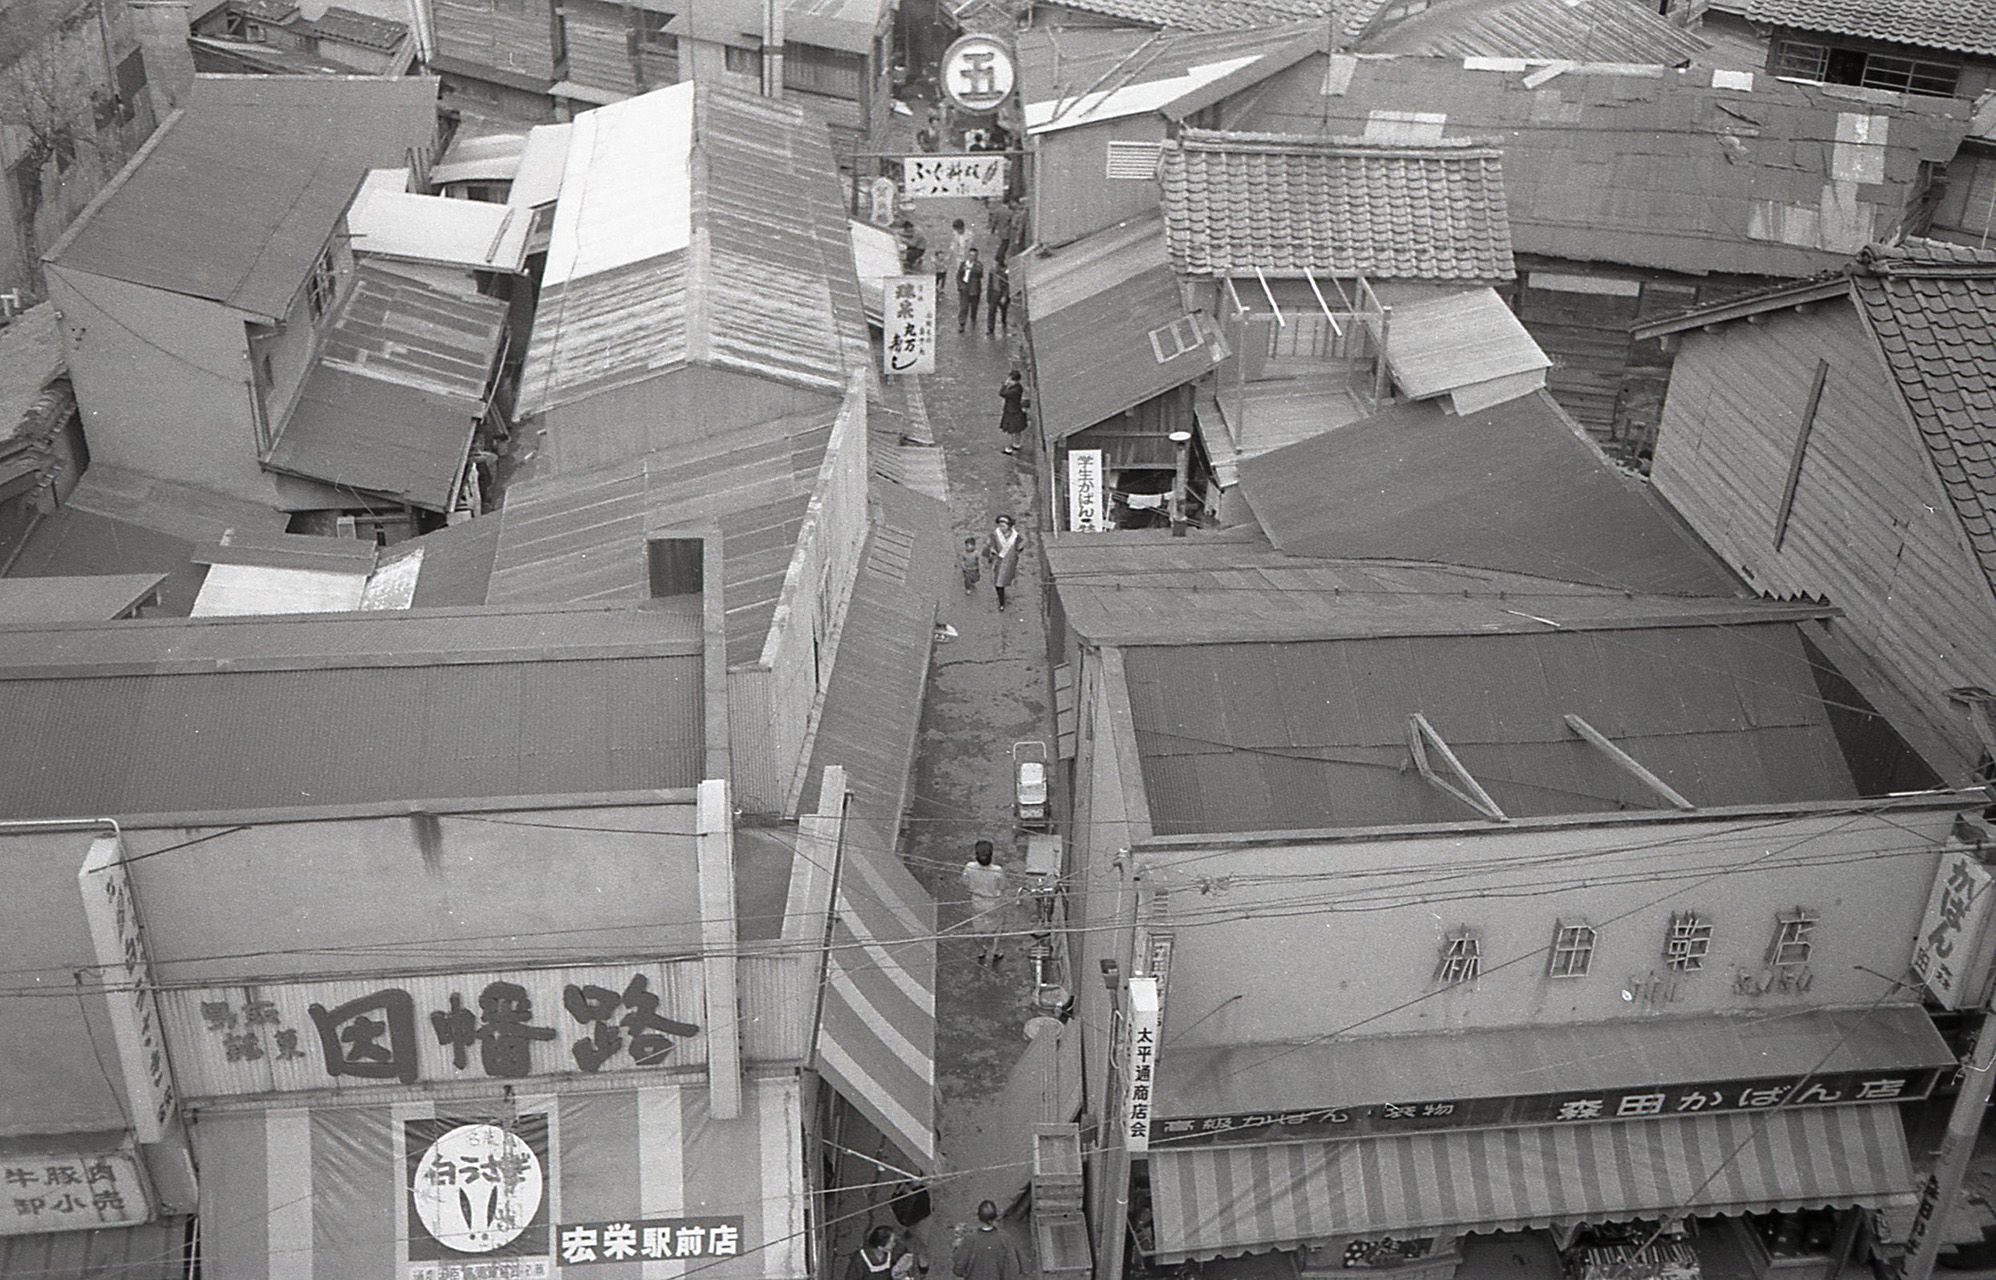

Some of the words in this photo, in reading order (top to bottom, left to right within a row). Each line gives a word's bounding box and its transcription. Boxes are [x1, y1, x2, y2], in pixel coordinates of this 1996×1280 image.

[1928, 858, 1976, 960] かばん
[308, 972, 701, 1085] 因幡路
[1129, 1027, 1154, 1138] 太平通商店会
[1556, 1079, 1905, 1121] 森田かばん店
[5, 1163, 117, 1188] 牛豚肉
[13, 1190, 125, 1215] 卸小売
[561, 1223, 739, 1264] 宏栄駅前店
